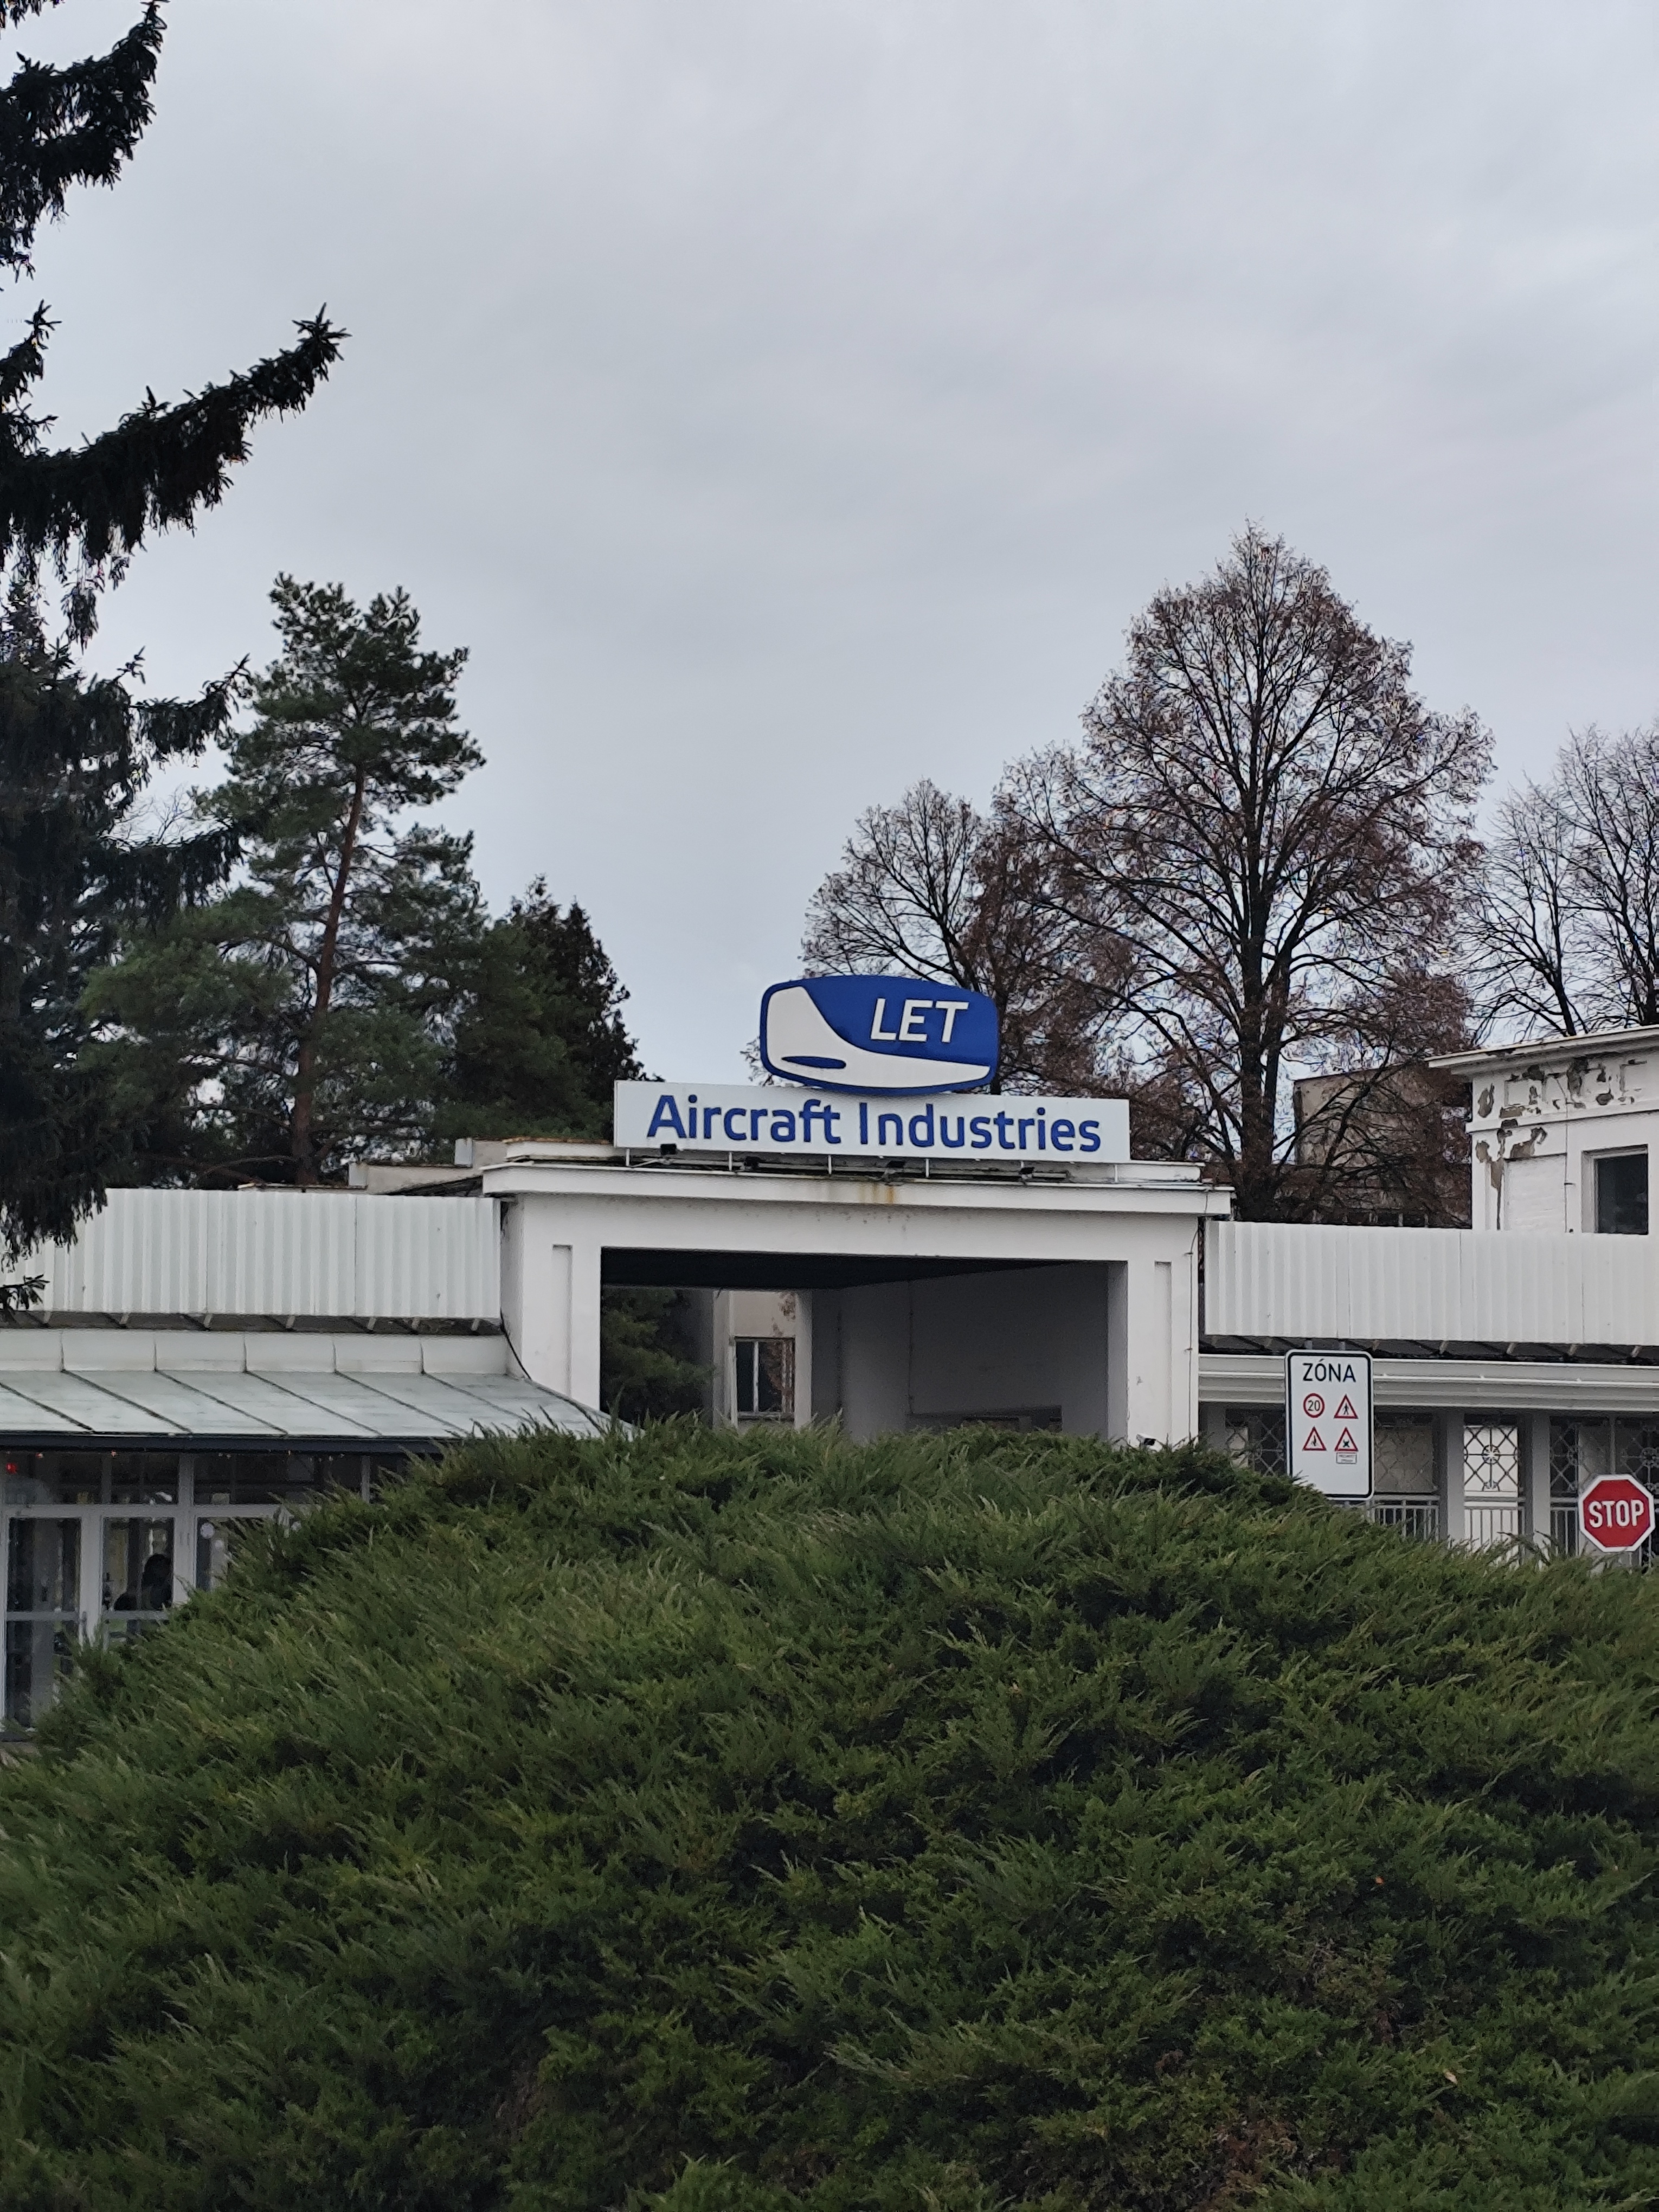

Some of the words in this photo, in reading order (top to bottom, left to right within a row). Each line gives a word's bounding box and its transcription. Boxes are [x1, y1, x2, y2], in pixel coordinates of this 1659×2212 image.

[870, 998, 969, 1043] LET
[647, 1095, 841, 1144] Aircraft
[860, 1103, 1101, 1152] Industries
[1302, 1359, 1356, 1382] ZÓNA
[1308, 1400, 1321, 1412] 20
[1589, 1499, 1644, 1528] STOP
